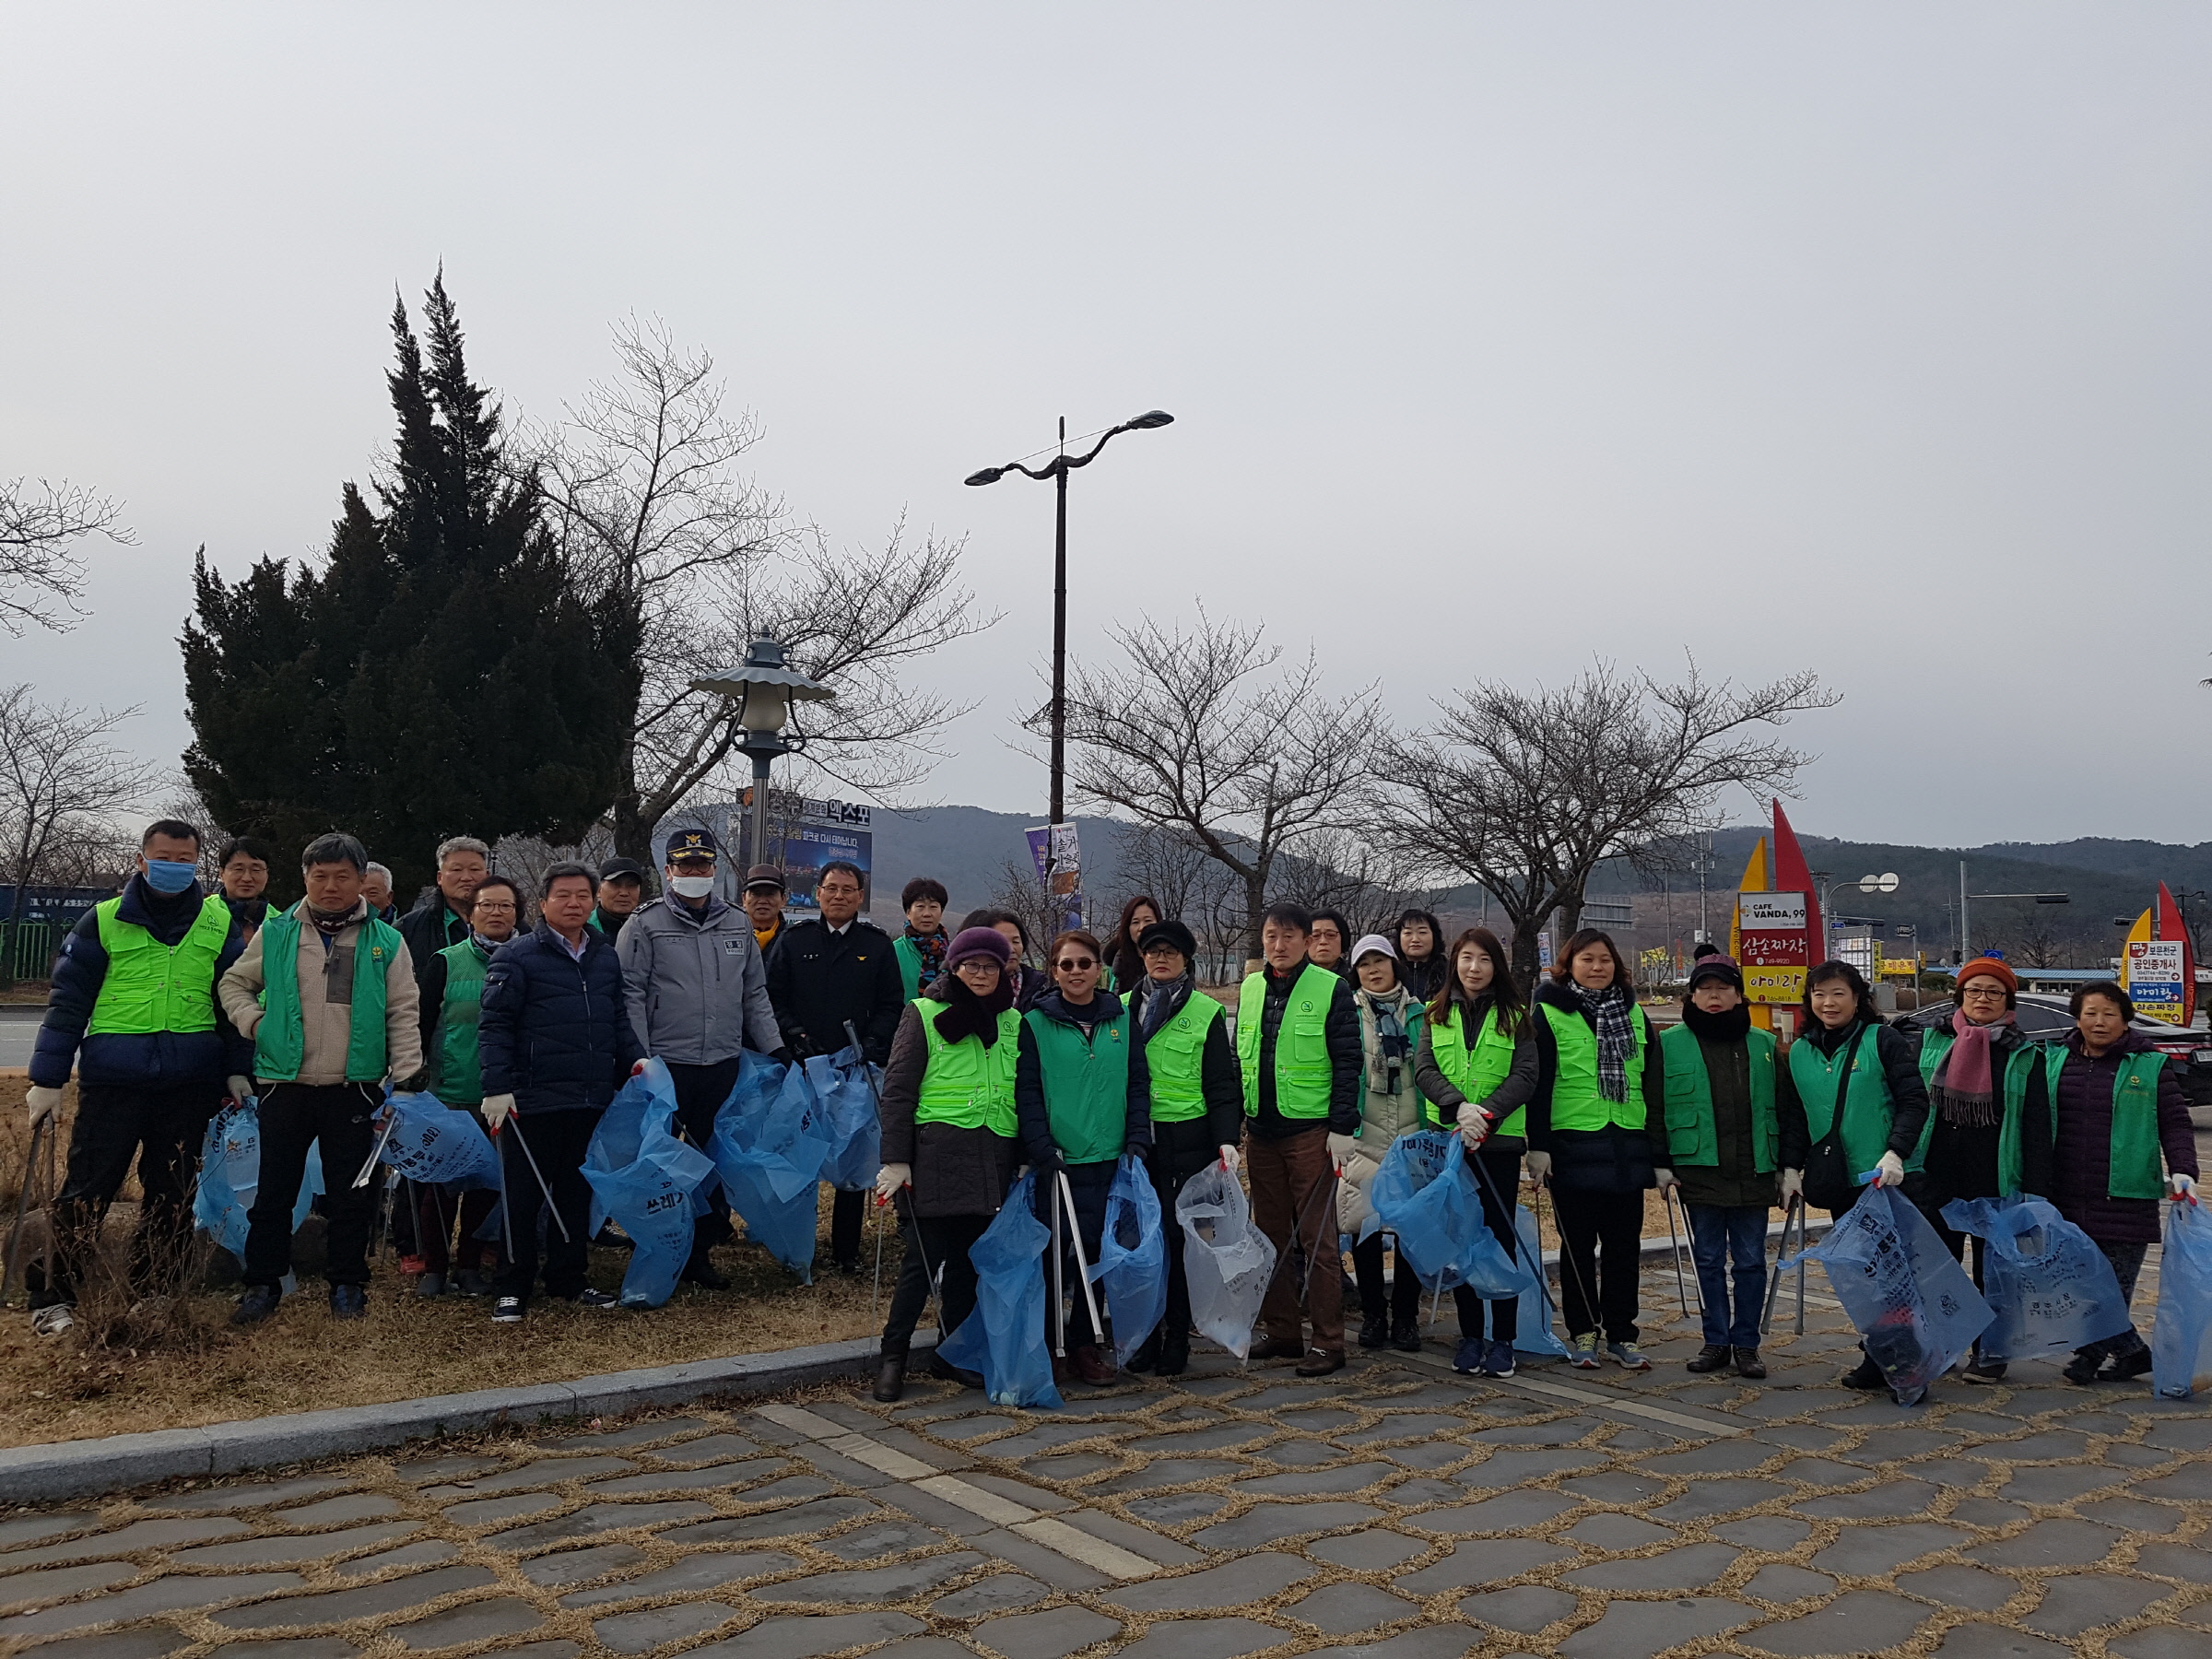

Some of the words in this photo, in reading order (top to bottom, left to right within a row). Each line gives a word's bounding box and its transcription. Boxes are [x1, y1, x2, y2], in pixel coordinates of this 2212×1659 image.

[830, 800, 870, 826] 엑스포
[1743, 937, 1806, 956] 삼손짜장
[2134, 959, 2177, 970] 공인중개사
[1750, 973, 1802, 993] 아미랑
[2136, 988, 2172, 1000] 아미랑
